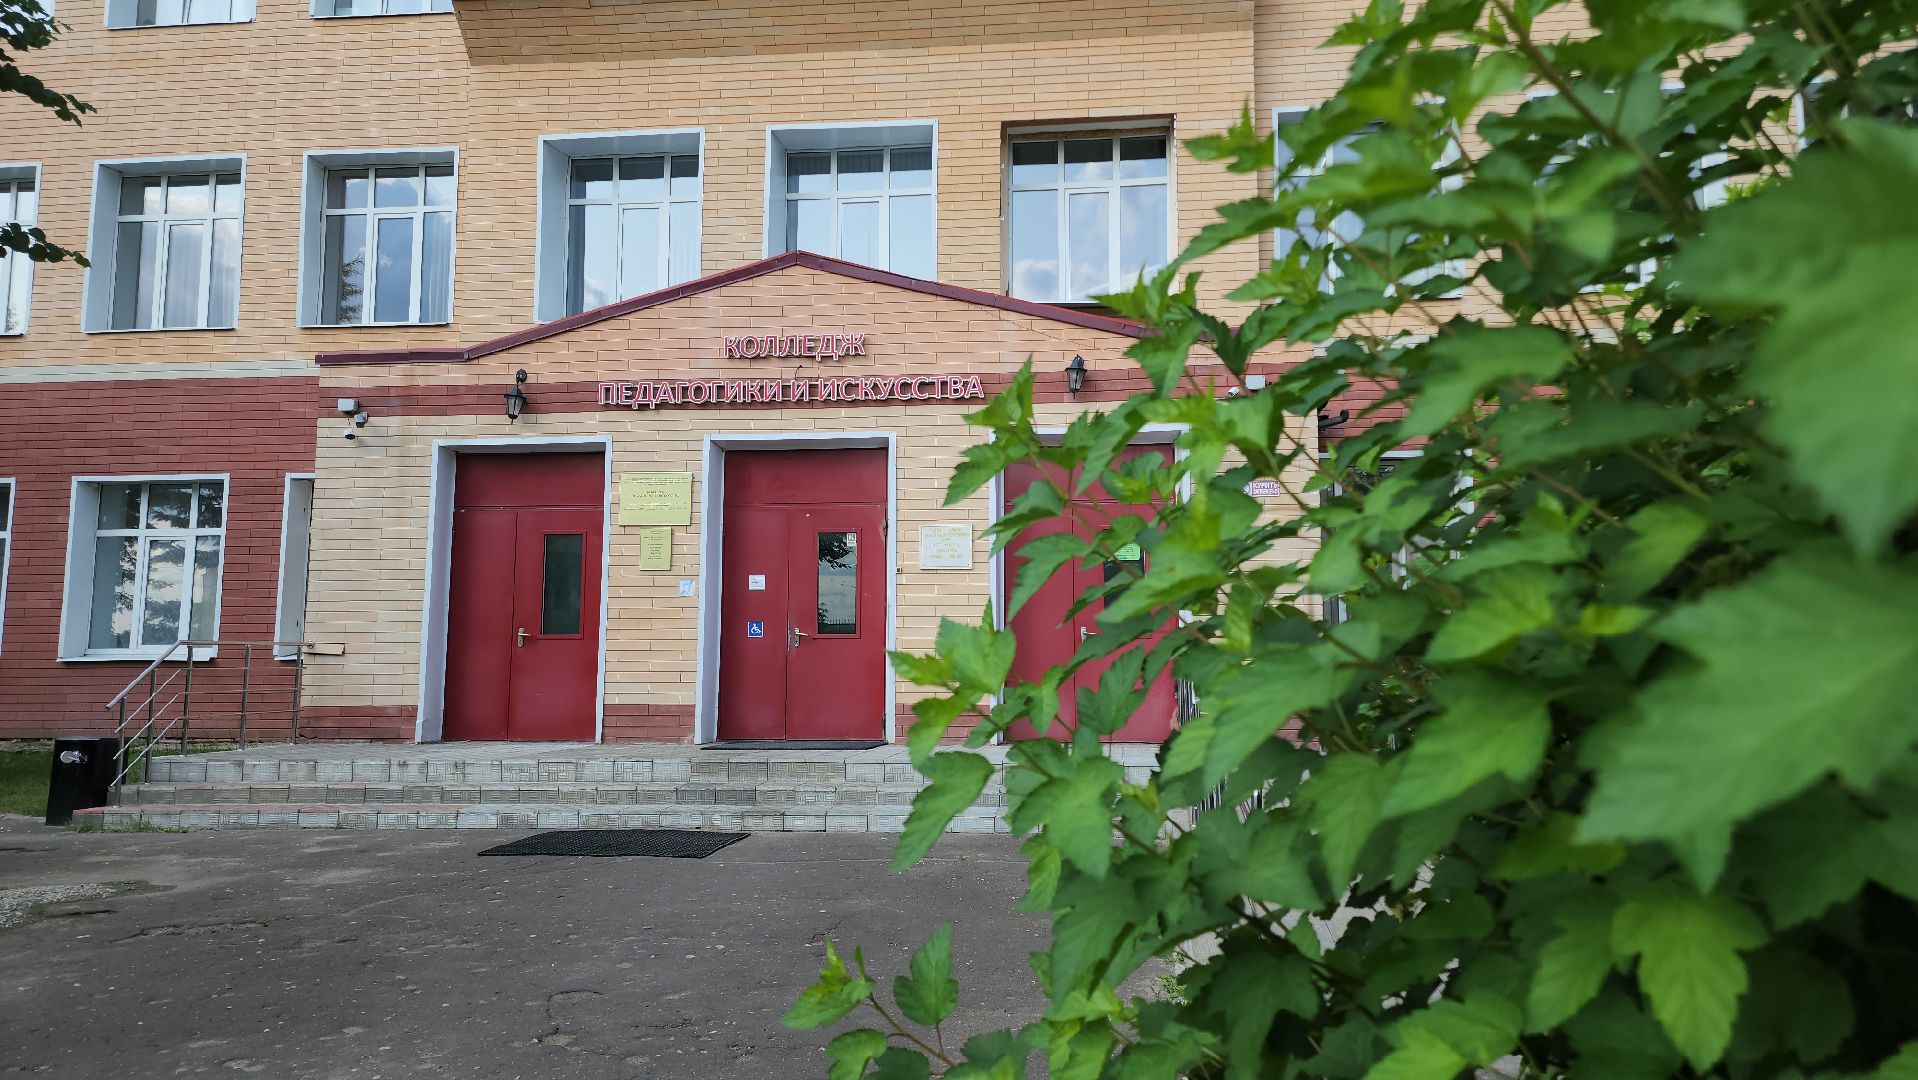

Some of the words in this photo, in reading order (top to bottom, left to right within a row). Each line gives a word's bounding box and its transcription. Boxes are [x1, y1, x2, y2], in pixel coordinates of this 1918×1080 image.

[723, 334, 865, 361] КОЛЛЕДЖ
[598, 378, 782, 409] ПЕДАГОГИКИ
[790, 378, 809, 402] И
[818, 375, 985, 402] ИСКУССТВА
